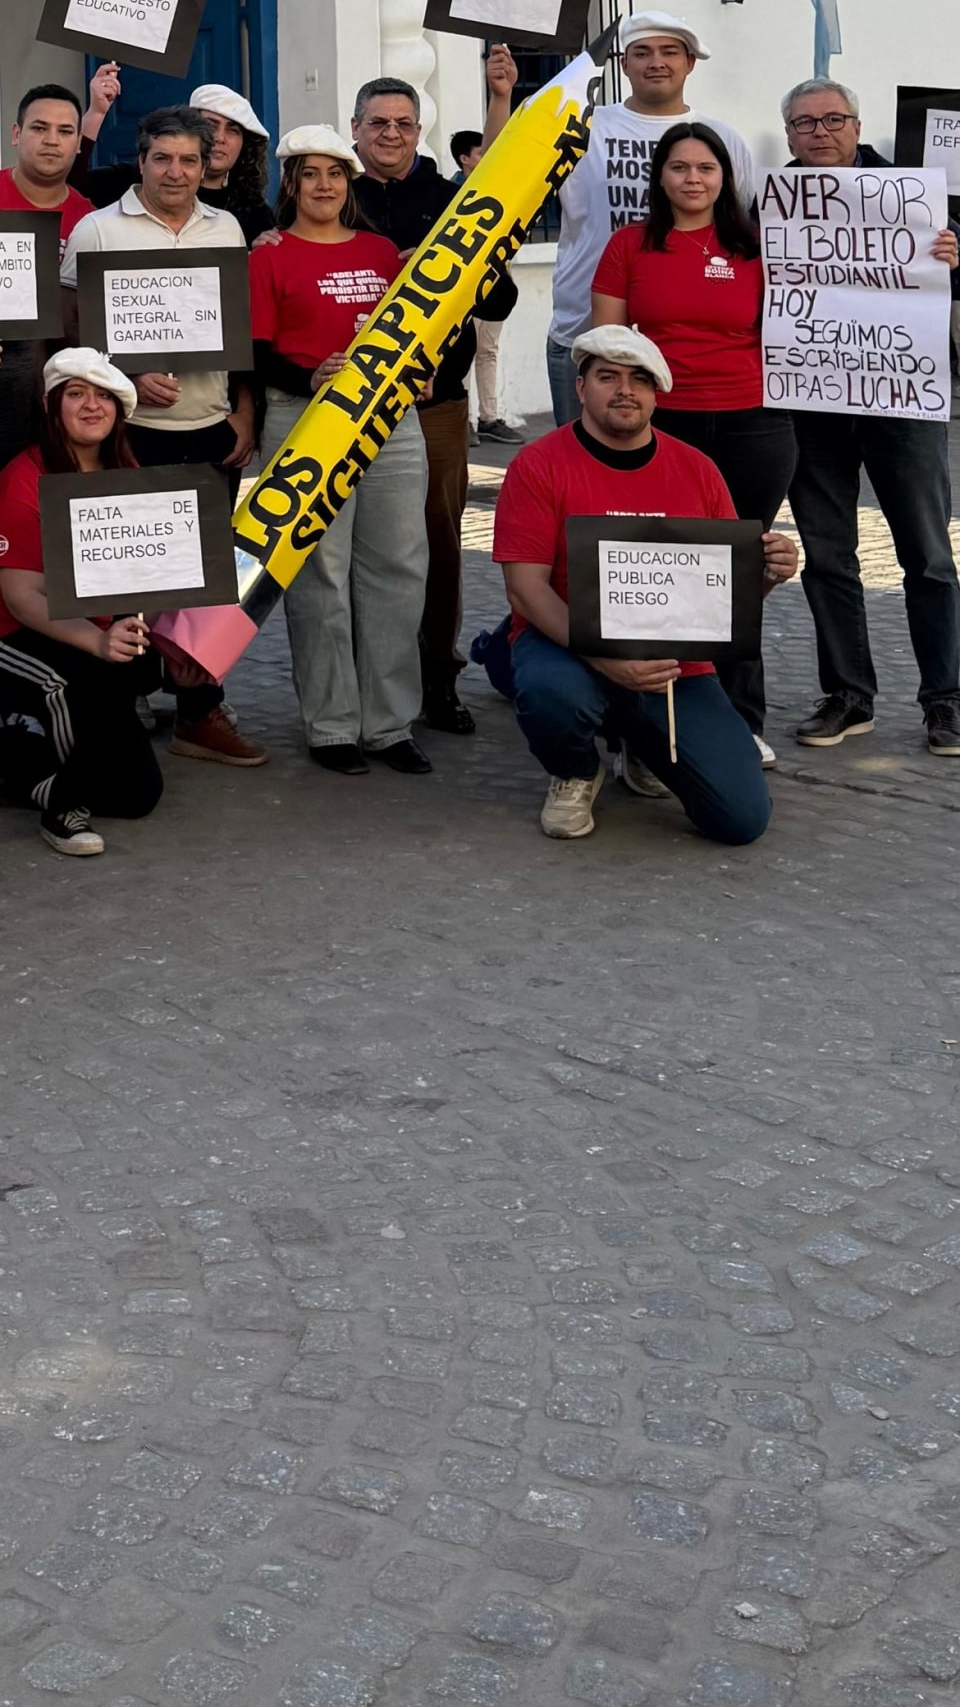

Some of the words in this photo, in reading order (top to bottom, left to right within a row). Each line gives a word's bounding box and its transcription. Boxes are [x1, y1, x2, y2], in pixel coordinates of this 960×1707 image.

[760, 173, 851, 224] AYER
[855, 173, 933, 228] POR
[17, 241, 31, 253] EN
[765, 226, 802, 260] EL
[799, 224, 915, 265] BOLETO
[111, 276, 192, 290] EDUCACION
[320, 285, 368, 295] PERSISTIR
[369, 285, 380, 293] ES
[336, 278, 355, 287] QUE
[112, 294, 166, 307] SEXUAL
[768, 288, 818, 319] HOY
[113, 311, 181, 325] INTEGRAL
[194, 310, 217, 322] SIN
[114, 328, 184, 342] GARANTIA
[233, 448, 323, 569] LOS
[318, 189, 505, 424] LAPICES
[767, 372, 843, 401] OTRAS
[846, 372, 945, 412] LUCHAS
[290, 341, 437, 551] SIGUEN
[78, 506, 123, 522] FALTA
[173, 500, 193, 514] DE
[80, 522, 174, 542] MATERIALES
[184, 520, 194, 533] Y
[81, 542, 166, 562] RECURSOS
[607, 550, 700, 566] EDUCACION
[608, 571, 675, 586] PUBLICA
[706, 573, 726, 587] EN
[608, 591, 669, 606] RIESGO
